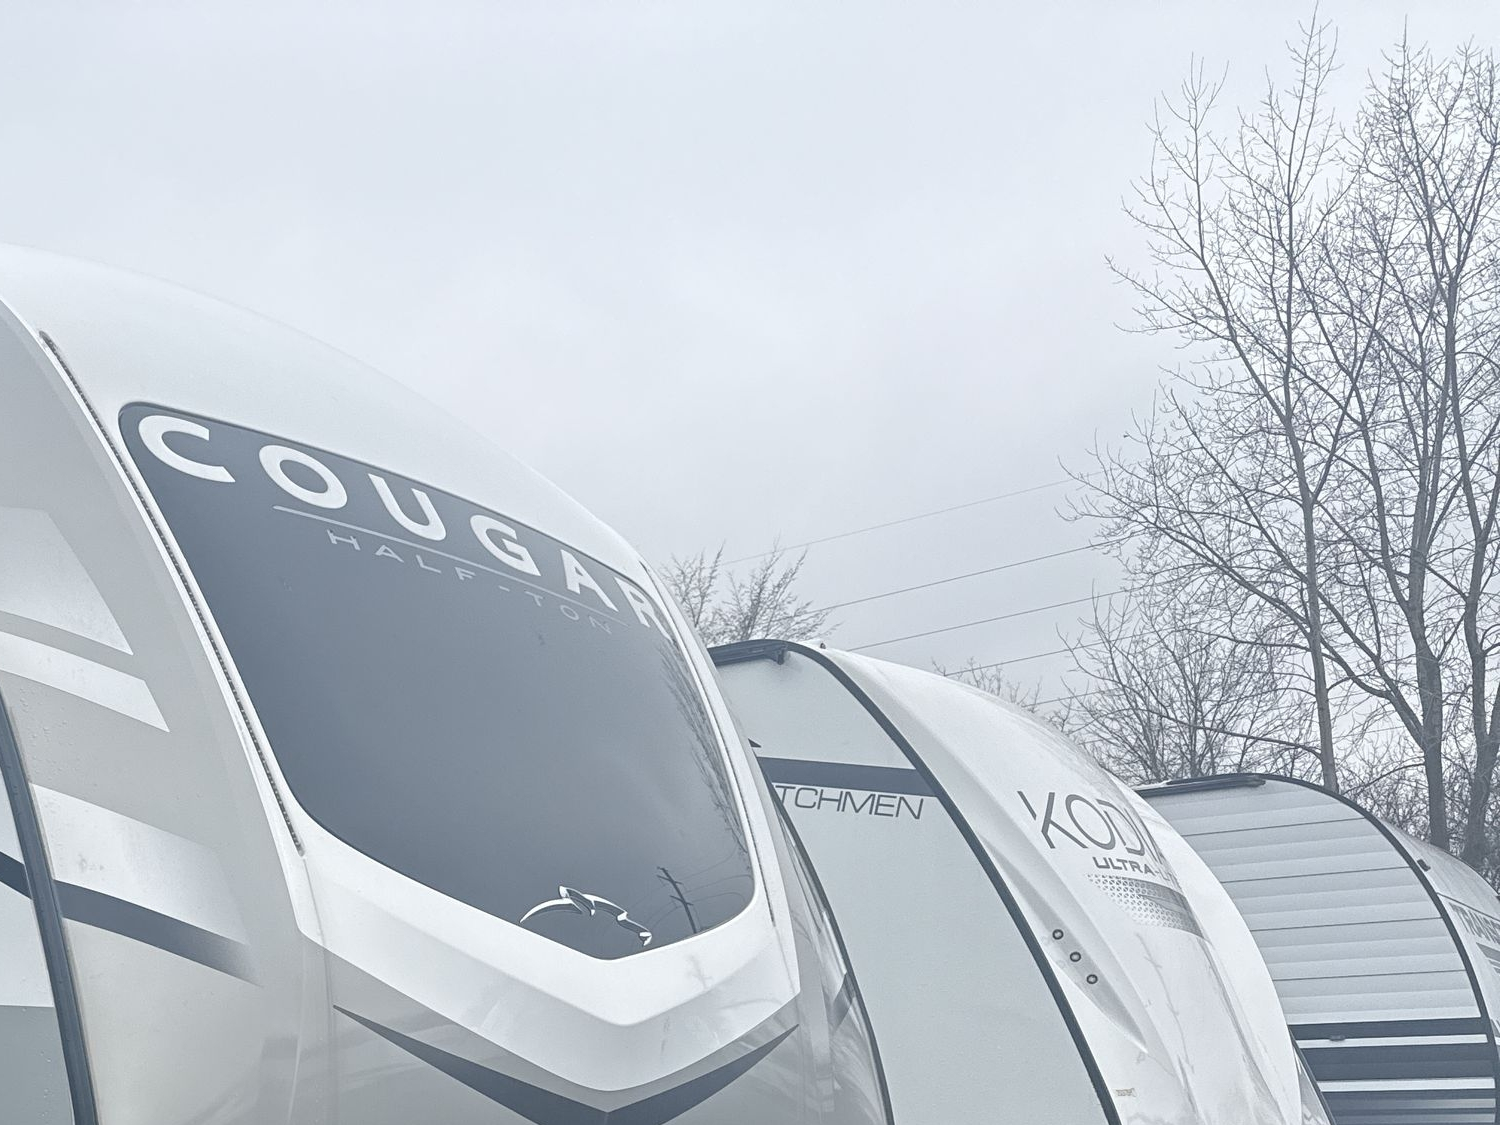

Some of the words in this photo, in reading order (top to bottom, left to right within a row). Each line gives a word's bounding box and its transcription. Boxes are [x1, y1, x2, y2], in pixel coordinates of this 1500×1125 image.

[138, 415, 673, 642] COUGAR
[775, 784, 924, 820] TCHMEN
[1017, 790, 1167, 865] KODI
